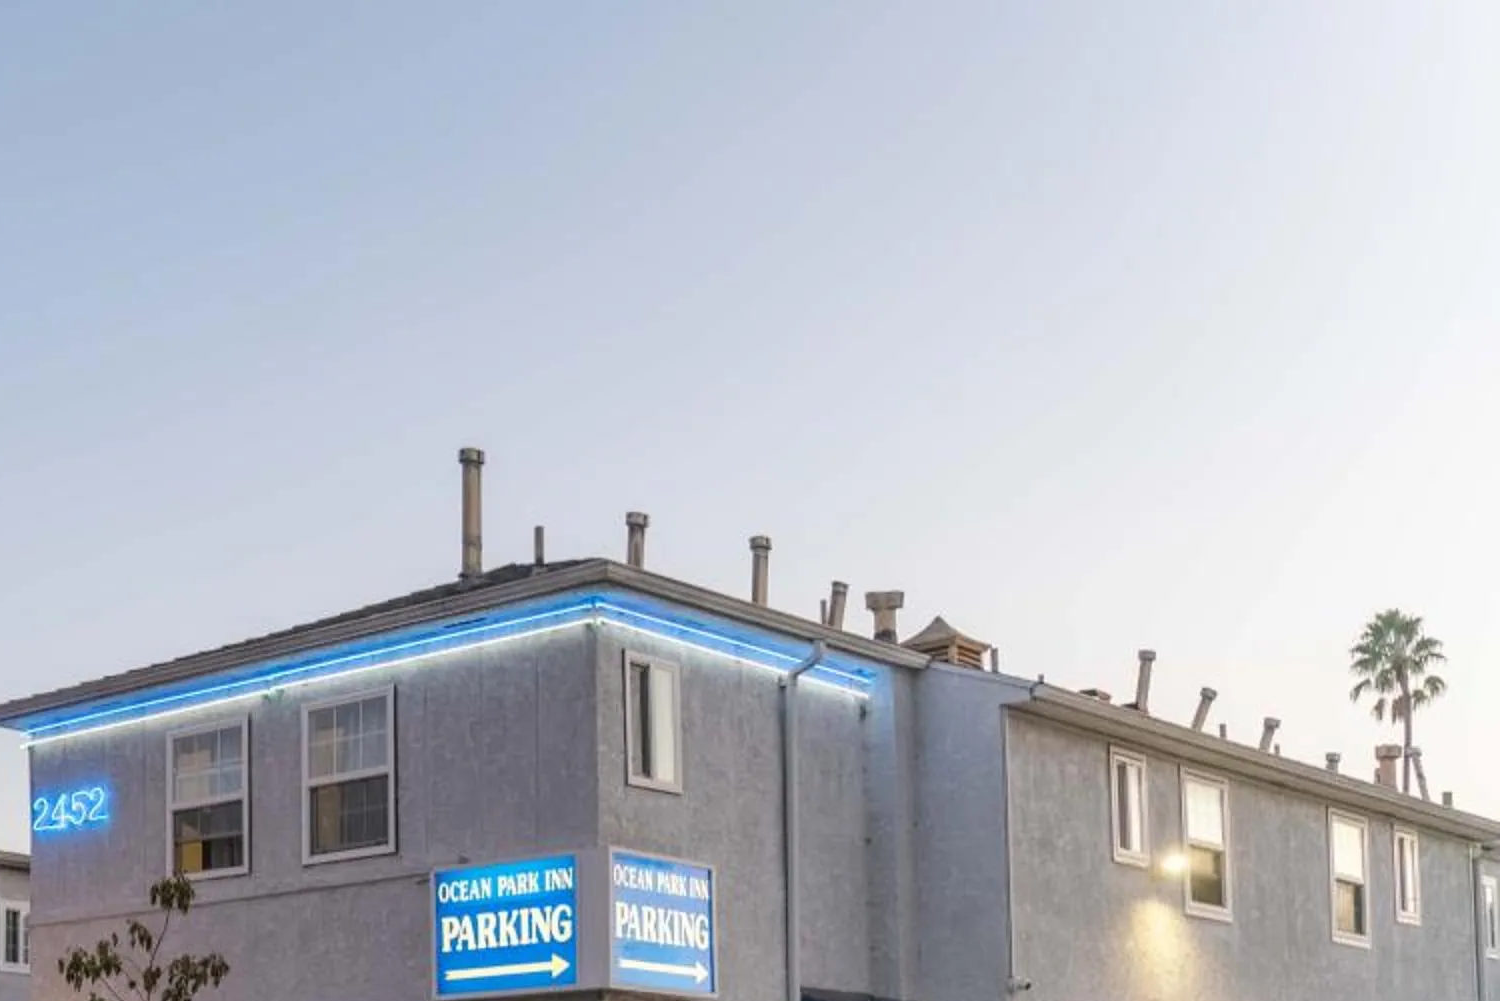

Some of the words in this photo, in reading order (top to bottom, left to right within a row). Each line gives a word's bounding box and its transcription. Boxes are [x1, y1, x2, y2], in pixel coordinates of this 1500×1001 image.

[33, 786, 109, 831] 2452
[438, 877, 492, 903] OCEAN
[497, 872, 539, 898] PARK
[544, 866, 574, 891] INN
[613, 863, 654, 892] OCEAN
[656, 871, 688, 898] PARK
[689, 878, 710, 901] INN
[440, 903, 574, 953] PARKING
[614, 900, 710, 950] PARKING
